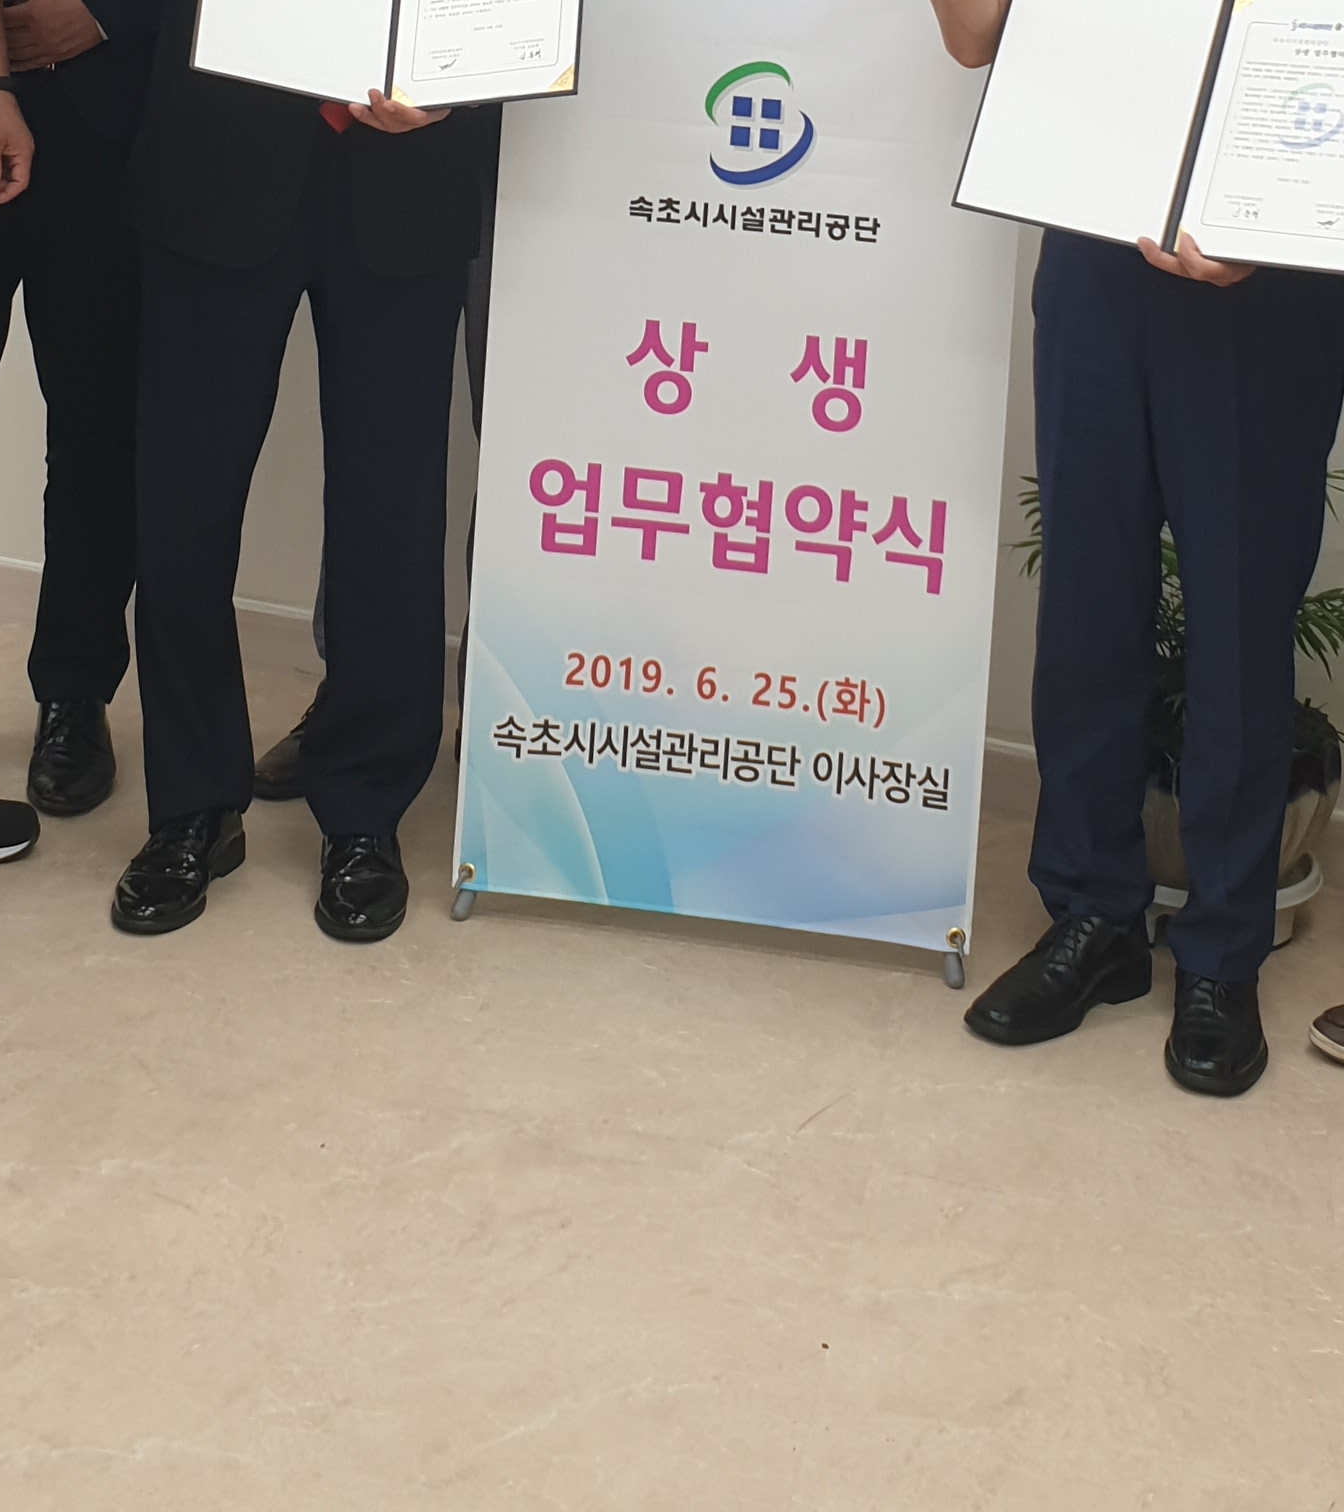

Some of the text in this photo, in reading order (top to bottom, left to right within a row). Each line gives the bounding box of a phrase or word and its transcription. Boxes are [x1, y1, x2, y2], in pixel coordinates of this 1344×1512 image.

[628, 195, 881, 244] 속초시시설관리공단
[624, 318, 868, 433] 상 생
[528, 458, 948, 595] 업무협약식
[564, 651, 887, 729] 2019. 6. 25.(화)
[492, 715, 950, 811] 속초시시설관리공단 이사장실
